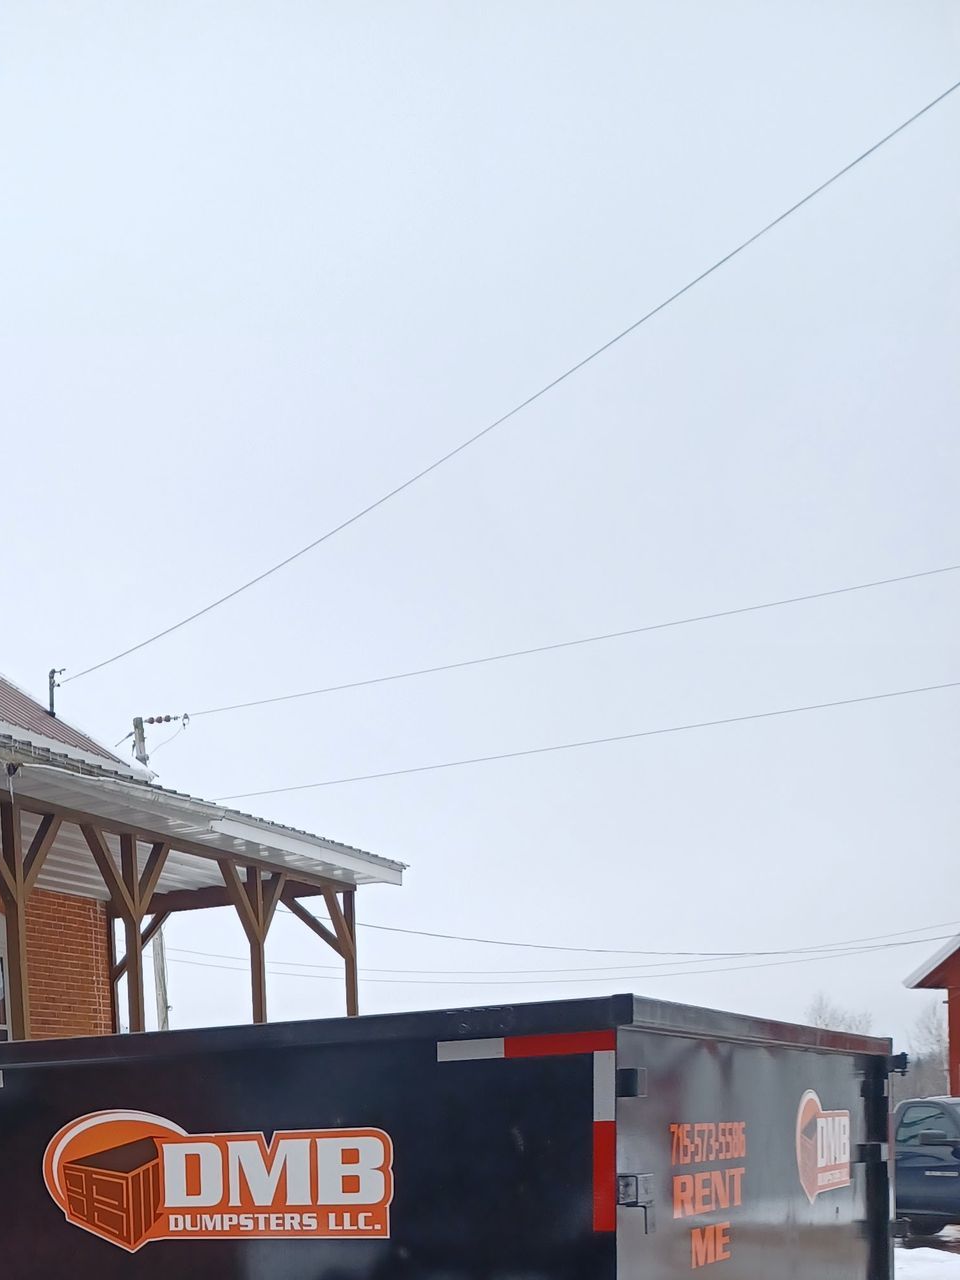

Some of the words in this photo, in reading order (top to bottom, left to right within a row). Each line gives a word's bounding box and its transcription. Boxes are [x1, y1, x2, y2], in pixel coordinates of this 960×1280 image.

[817, 1116, 850, 1168] DMB
[163, 1136, 385, 1208] DMB
[672, 1167, 745, 1219] RENT
[169, 1212, 318, 1231] DUMPSTERS
[327, 1212, 382, 1231] LLC.
[691, 1221, 731, 1269] ME
